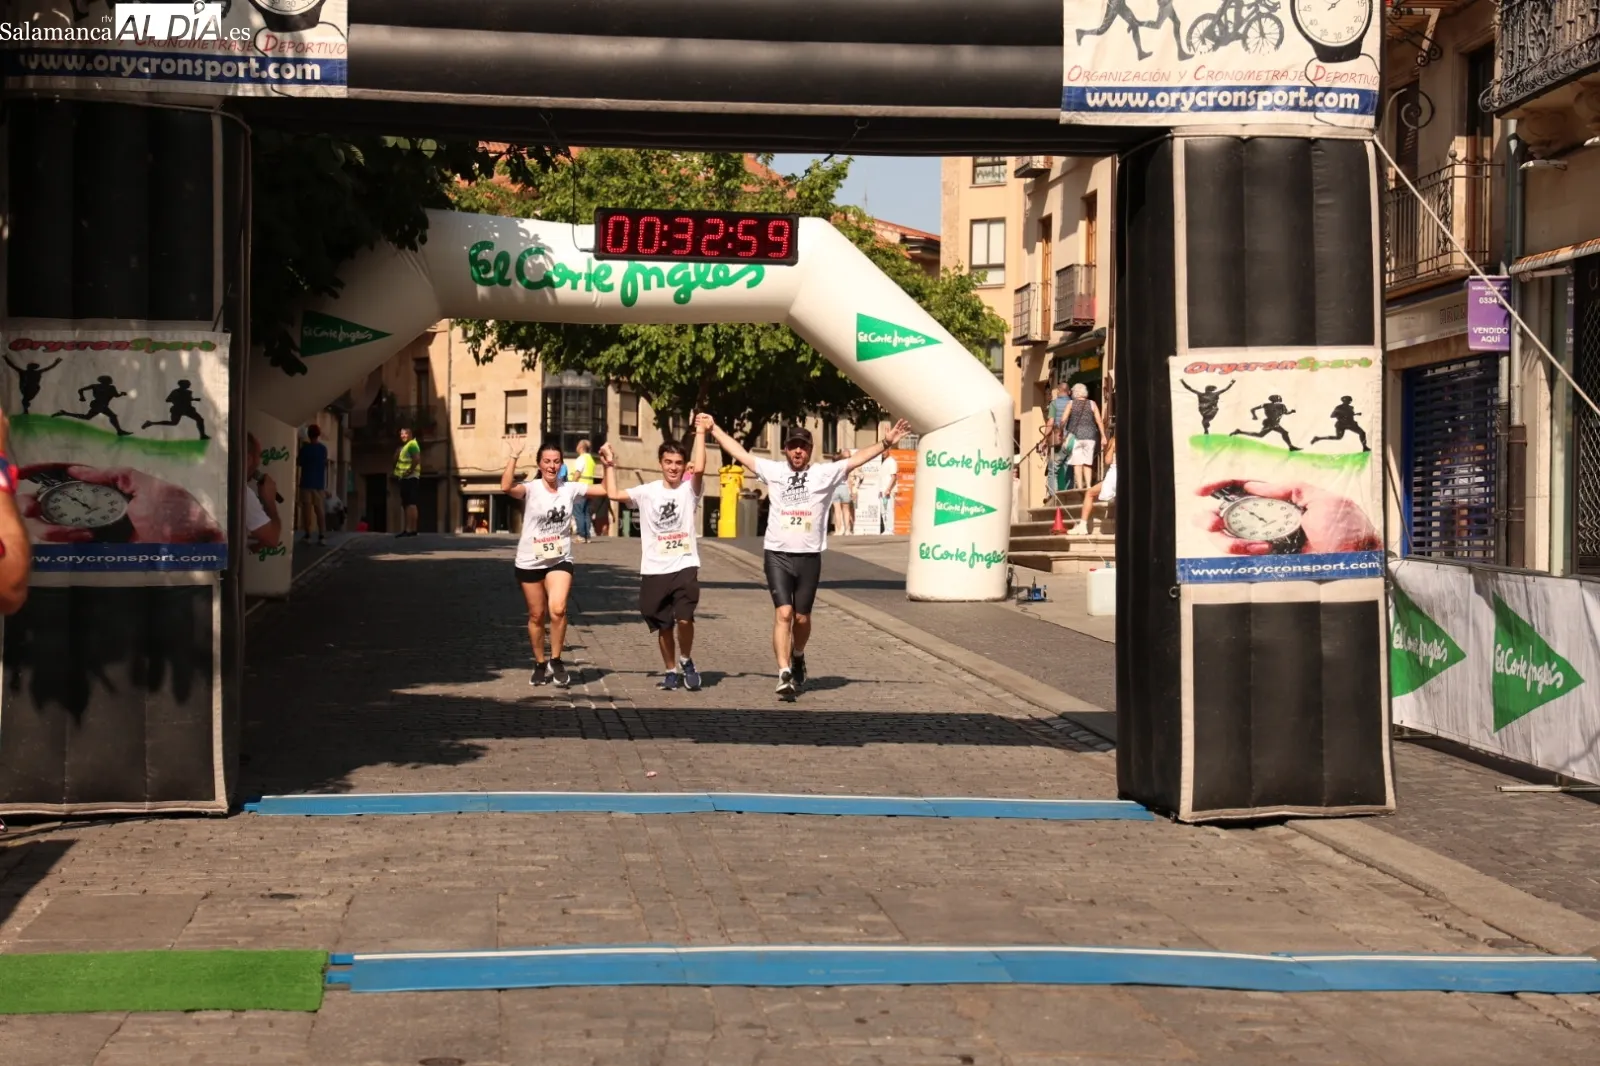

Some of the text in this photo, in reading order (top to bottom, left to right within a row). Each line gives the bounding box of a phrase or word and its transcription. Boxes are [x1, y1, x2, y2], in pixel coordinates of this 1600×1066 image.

[262, 33, 348, 55] DEPORTIVO
[19, 53, 321, 81] www.orycronsport.com
[1193, 64, 1305, 83] CRONOMETRAJE
[1312, 64, 1380, 87] DEPORTIVO
[1085, 86, 1360, 112] www.orycronsport.com
[605, 214, 790, 259] 00:32:59
[468, 240, 512, 288] El
[514, 246, 615, 293] Corte
[260, 446, 290, 465] glés
[925, 449, 937, 467] El
[937, 450, 973, 469] Corte
[790, 516, 803, 526] 22
[542, 542, 555, 552] 53
[665, 540, 684, 550] 224
[919, 542, 931, 560] El
[931, 543, 967, 562] Corte
[31, 553, 217, 565] w.orycronsport.com
[1190, 559, 1381, 577] www.orycronsport.com
[1494, 643, 1564, 695] El Corte Inglés
